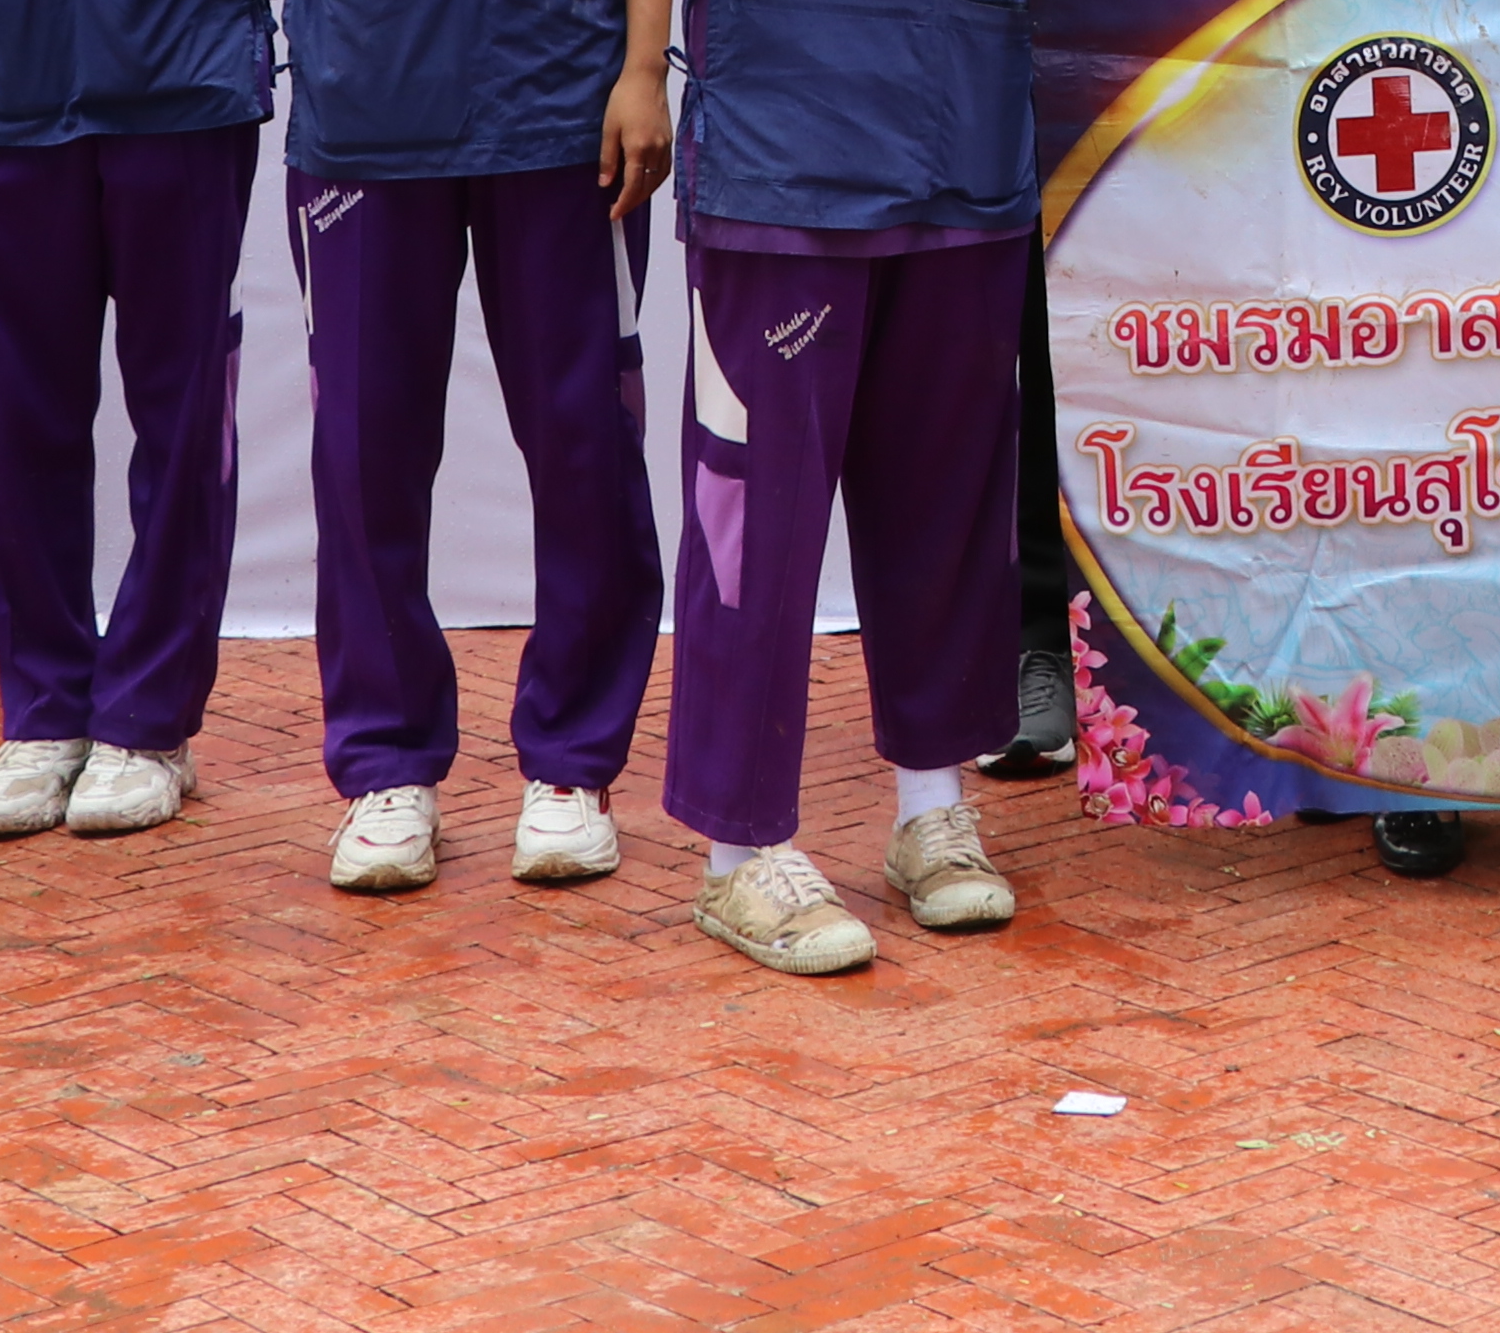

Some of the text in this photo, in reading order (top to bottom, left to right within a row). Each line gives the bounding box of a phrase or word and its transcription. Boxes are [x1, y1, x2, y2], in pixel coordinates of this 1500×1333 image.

[1309, 42, 1475, 113] อาสายุวกาชาด
[1306, 143, 1484, 226] RCY VOLUNTEER
